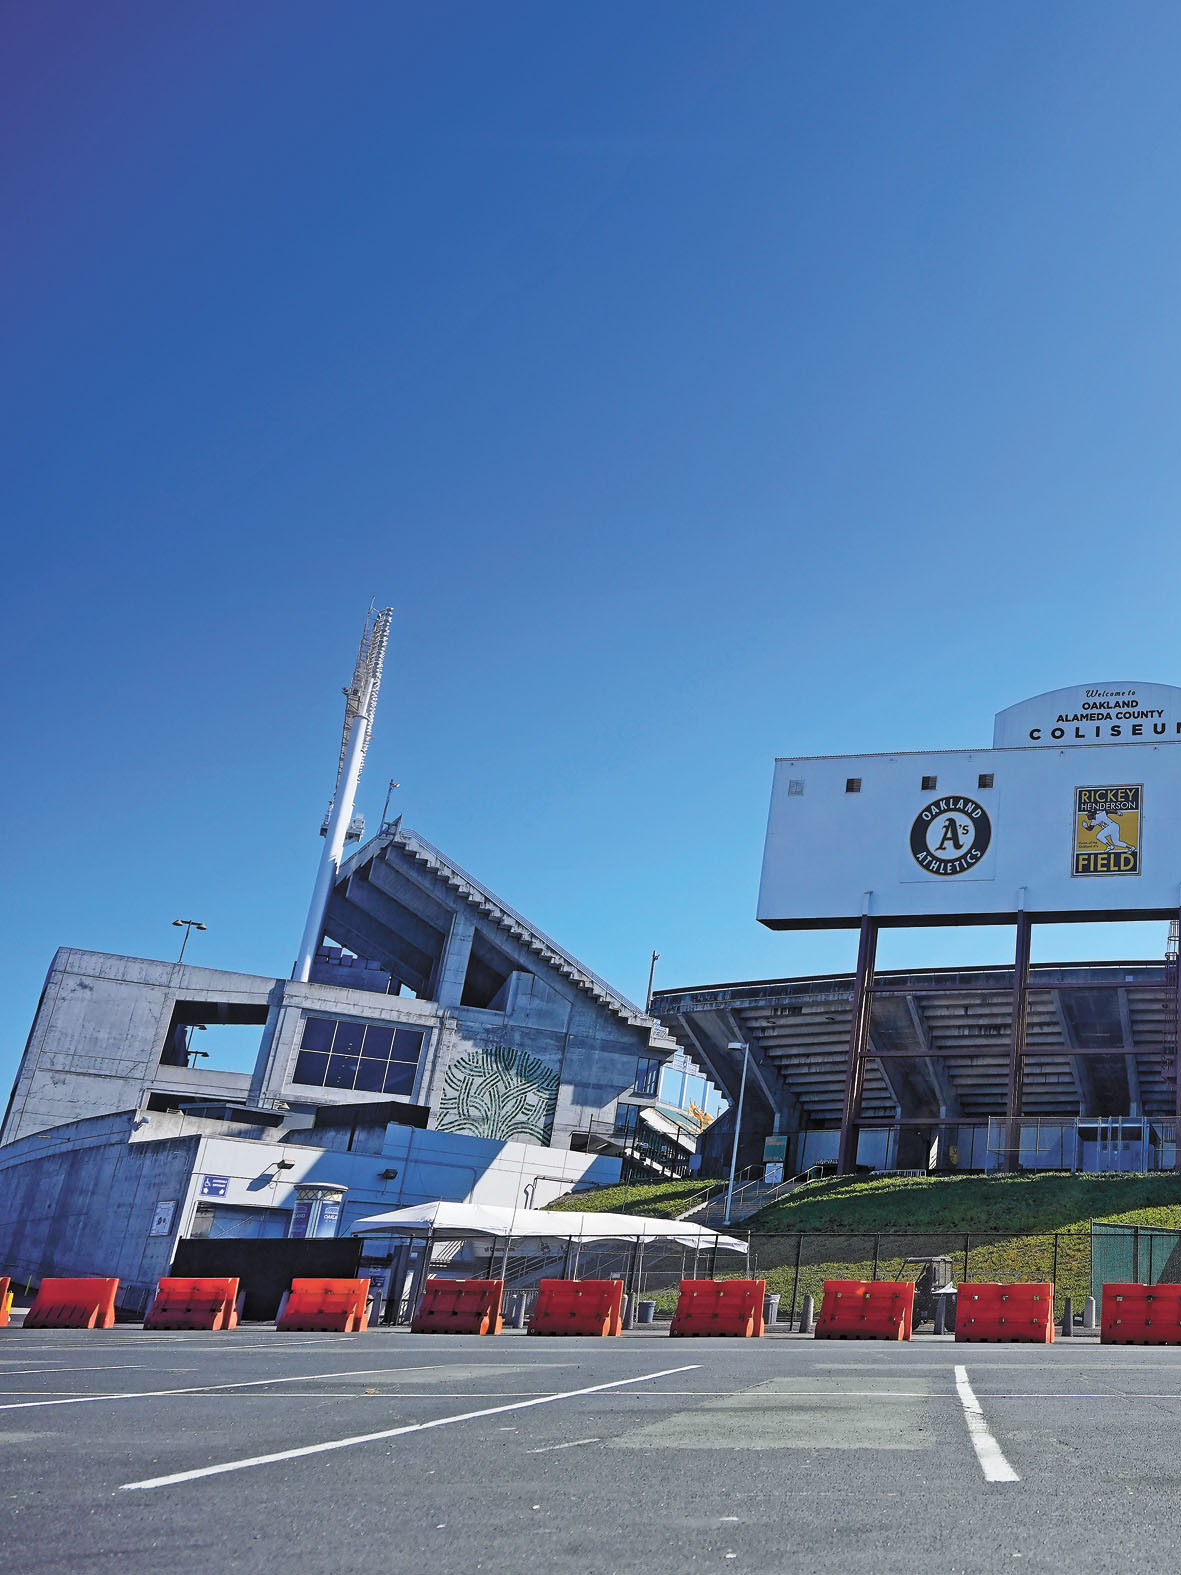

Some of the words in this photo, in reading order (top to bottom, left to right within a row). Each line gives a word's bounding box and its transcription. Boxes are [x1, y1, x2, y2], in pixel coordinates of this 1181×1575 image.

[1085, 689, 1125, 698] Welcome
[1082, 699, 1139, 711] OAKLAND
[1056, 711, 1113, 723] ALAMEDA
[1115, 710, 1165, 720] COUNTY
[1081, 788, 1136, 803] RICKEY
[922, 798, 982, 820] OAKLAND
[1081, 801, 1136, 811] HENDERSON
[916, 848, 981, 873] ATHLETICS
[1078, 853, 1135, 872] FIELD
